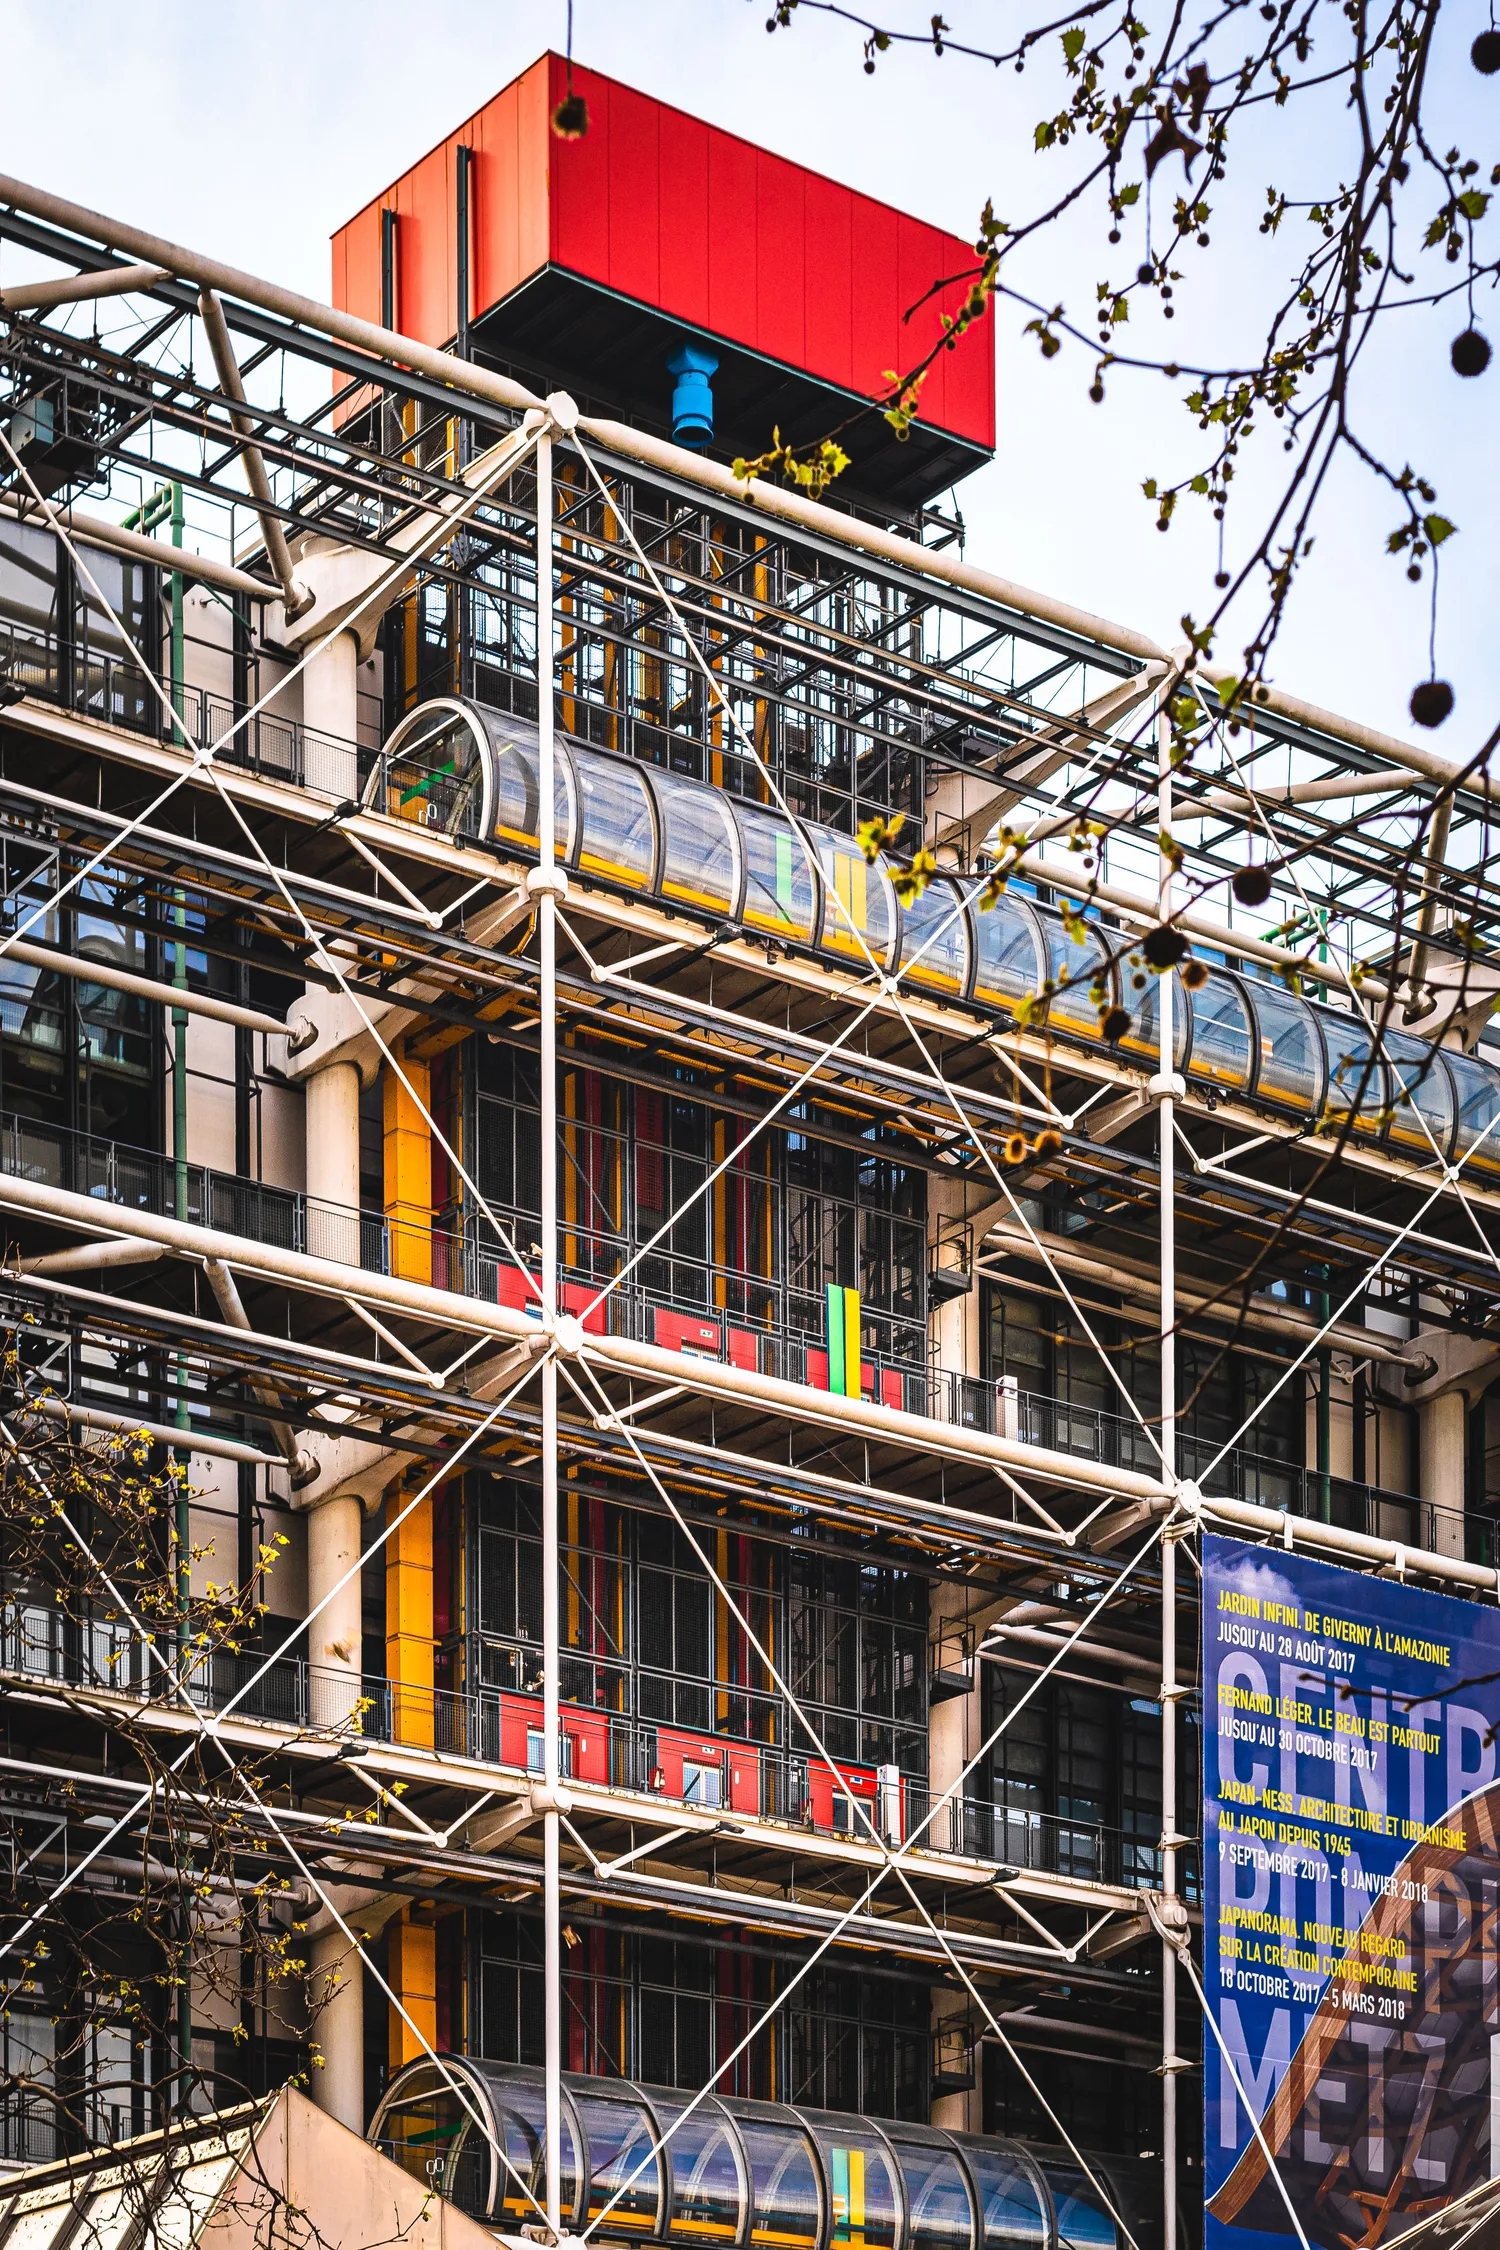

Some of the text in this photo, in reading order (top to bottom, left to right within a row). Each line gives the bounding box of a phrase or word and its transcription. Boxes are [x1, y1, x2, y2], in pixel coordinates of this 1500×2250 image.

[1217, 1590, 1450, 1667] JARDIN INFINI. DE GIVERNY À L'AMAZONIE
[1217, 1622, 1355, 1673] JUSQU'AU 28 AOÛT 2017
[1217, 1716, 1378, 1770] JUSQU'AU 30 OCTOBRE 2017
[1218, 1684, 1440, 1754] FERNAND LÉGER. LE BEAU EST PARTOUT
[1218, 1779, 1467, 1851] JAPAN-NESS. ARCHITECTURE ET URBANISME
[1218, 1810, 1351, 1856] AU JAPON DEPUIS 1945
[1218, 1842, 1225, 1861] 9
[1229, 1845, 1298, 1876] SEPTEMBRE
[1301, 1860, 1329, 1882] 2017
[1341, 1870, 1348, 1887] 8
[1351, 1871, 1398, 1897] JANVIER
[1401, 1882, 1428, 1903] 2018
[1218, 1904, 1405, 1959] JAPANORAMA. NOUVEAU REGARD
[1219, 1936, 1417, 1992] SUR LA CRÉATION CONTEMPORAINE
[1220, 1967, 1233, 1987] 18
[1237, 1972, 1289, 1999] OCTOBRE
[1293, 1981, 1320, 2004] 2017
[1332, 1989, 1338, 2008] 5
[1342, 1991, 1375, 2015] MARS
[1378, 1998, 1405, 2020] 2018
[1220, 1997, 1446, 2182] METZ
